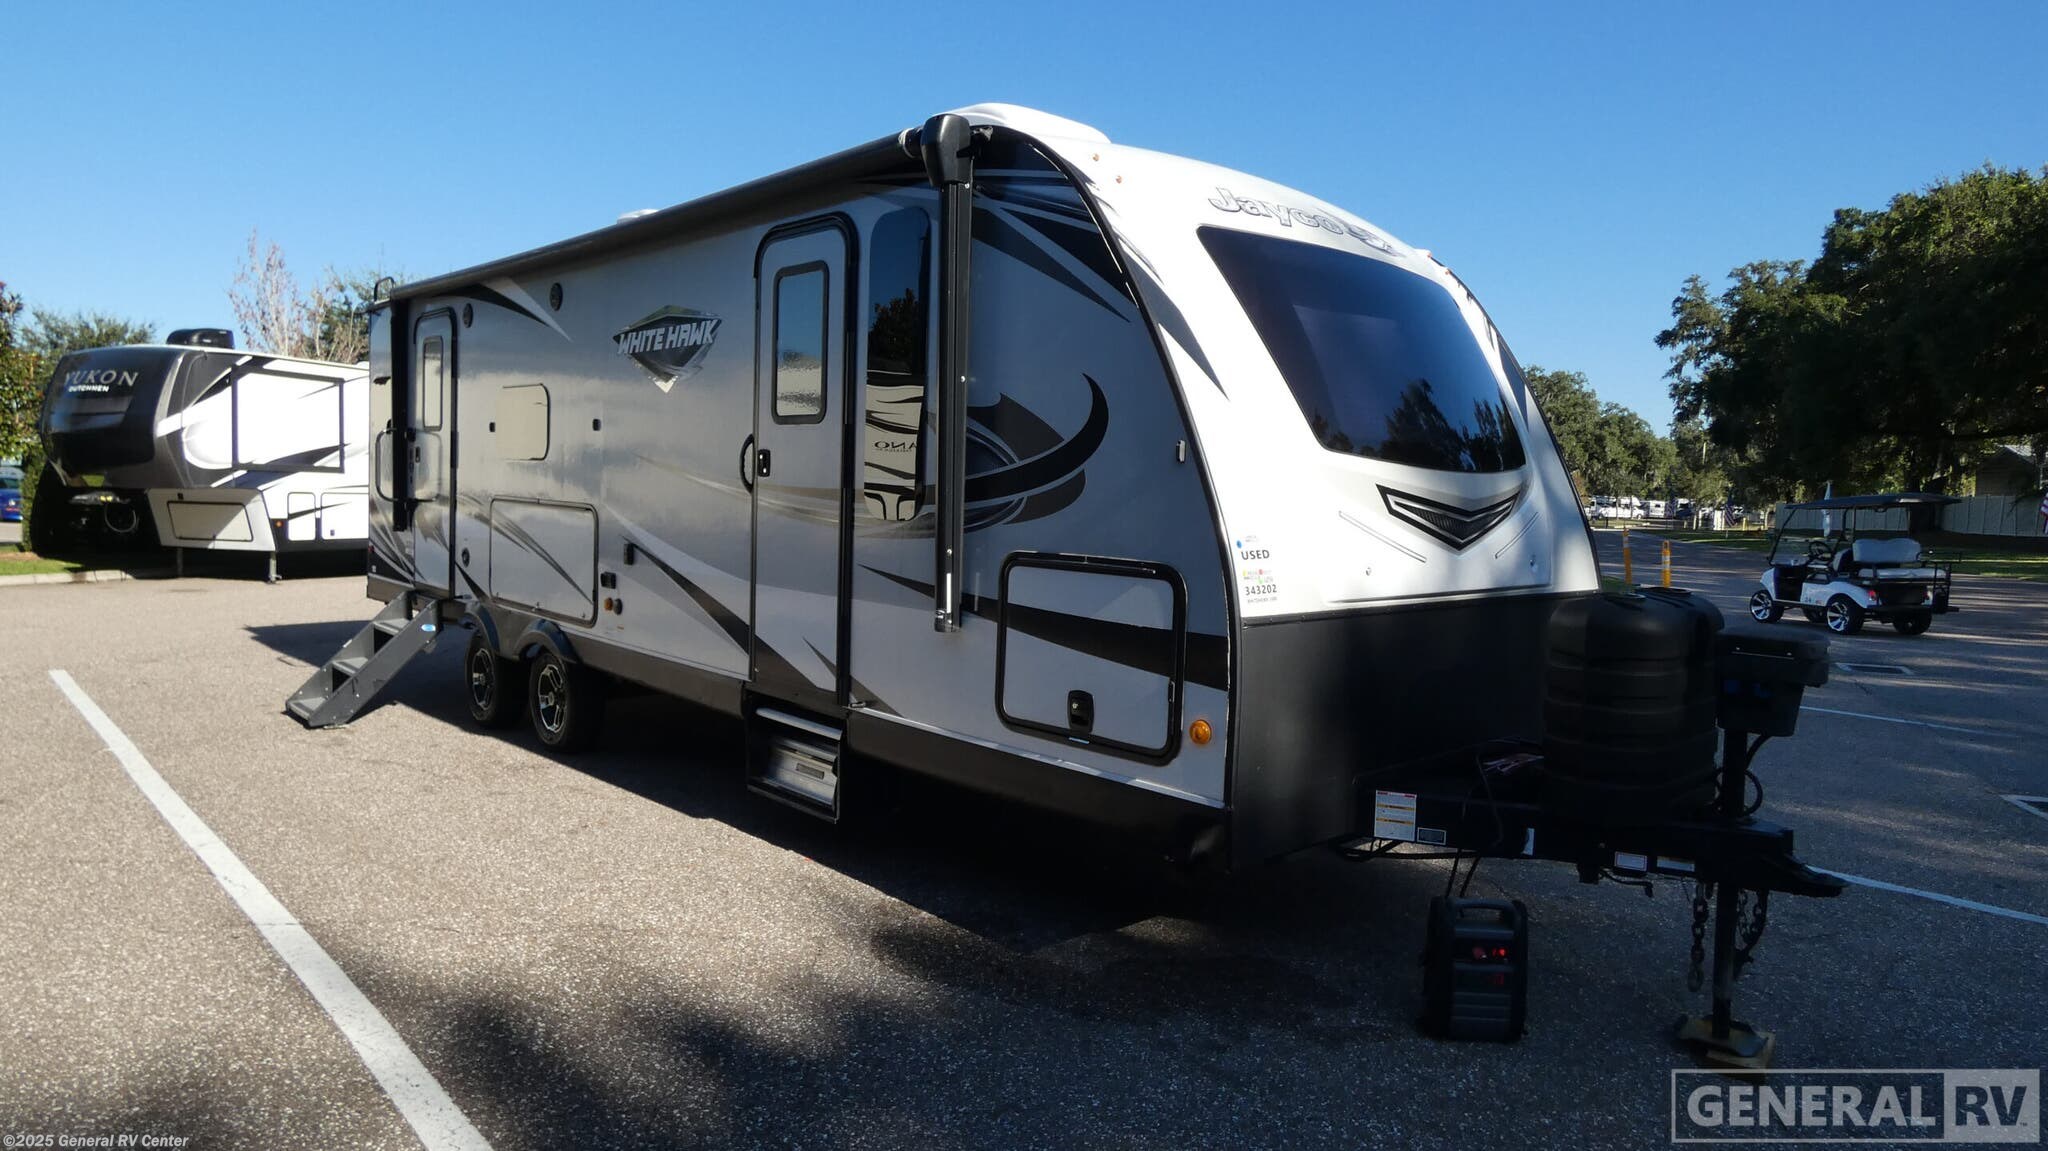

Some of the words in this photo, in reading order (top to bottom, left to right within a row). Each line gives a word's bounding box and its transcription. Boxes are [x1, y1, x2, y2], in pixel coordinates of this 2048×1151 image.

[1208, 187, 1344, 235] Jayco
[617, 327, 666, 355] WHITE
[665, 319, 719, 350] HAWK
[65, 369, 138, 386] YUKON
[68, 384, 110, 393] DUTCHMEN
[1241, 549, 1270, 561] USED
[1245, 584, 1278, 596] 343202
